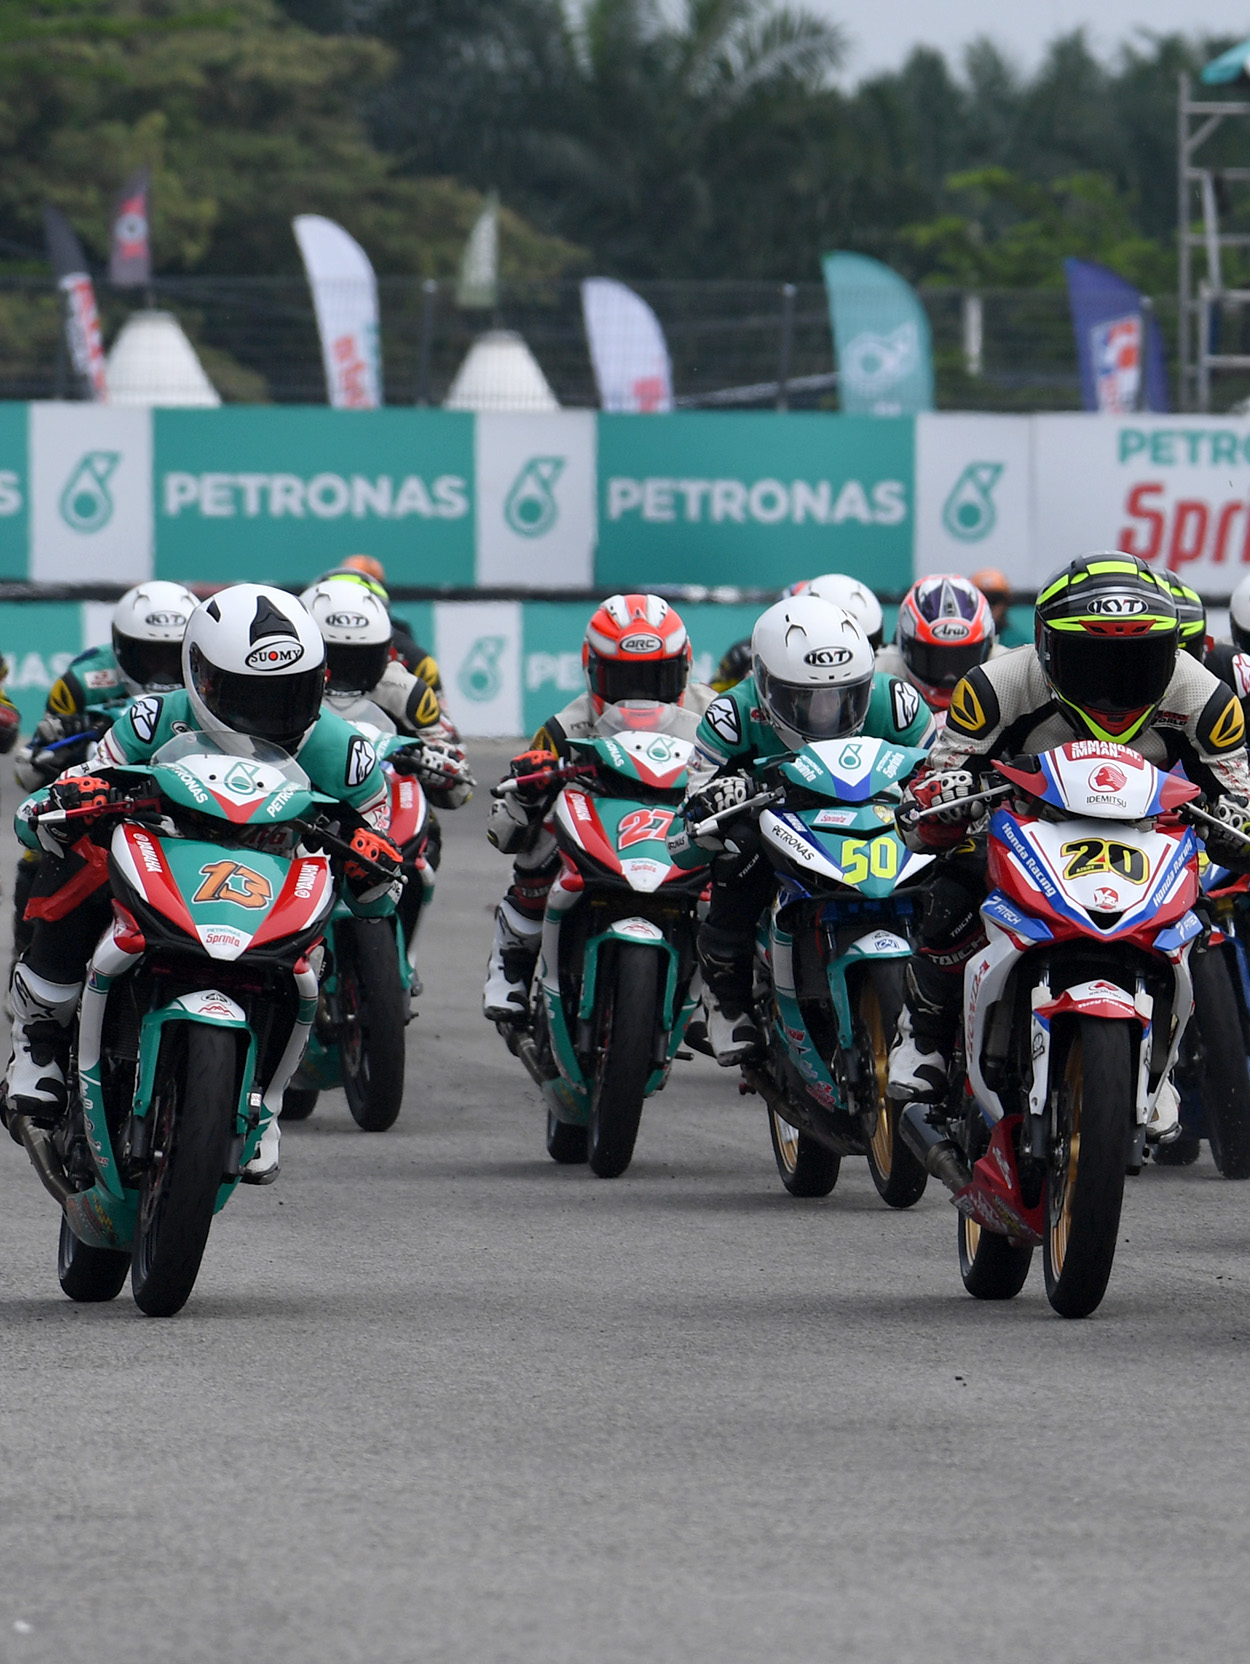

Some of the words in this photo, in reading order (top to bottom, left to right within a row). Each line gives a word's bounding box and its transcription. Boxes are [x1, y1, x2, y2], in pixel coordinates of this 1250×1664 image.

[163, 472, 470, 521] PETRONAS
[607, 478, 908, 526] PETRONAS
[1094, 599, 1139, 613] KYT
[149, 612, 184, 626] KYT
[329, 613, 367, 627] KYT
[933, 624, 967, 638] Arai
[625, 639, 656, 649] ARC
[250, 649, 301, 663] SUOMY
[811, 649, 850, 665] KYT
[1086, 794, 1127, 808] IDEMITSU
[616, 807, 676, 852] 27
[771, 824, 816, 861] PETRONAS
[841, 836, 898, 885] 50
[1001, 822, 1029, 859] Honda
[1025, 856, 1058, 898] Racing
[1060, 837, 1151, 886] 20
[191, 858, 275, 911] 13
[1152, 870, 1176, 908] Honda
[994, 903, 1022, 926] FITECH
[205, 932, 242, 948] Sprinta
